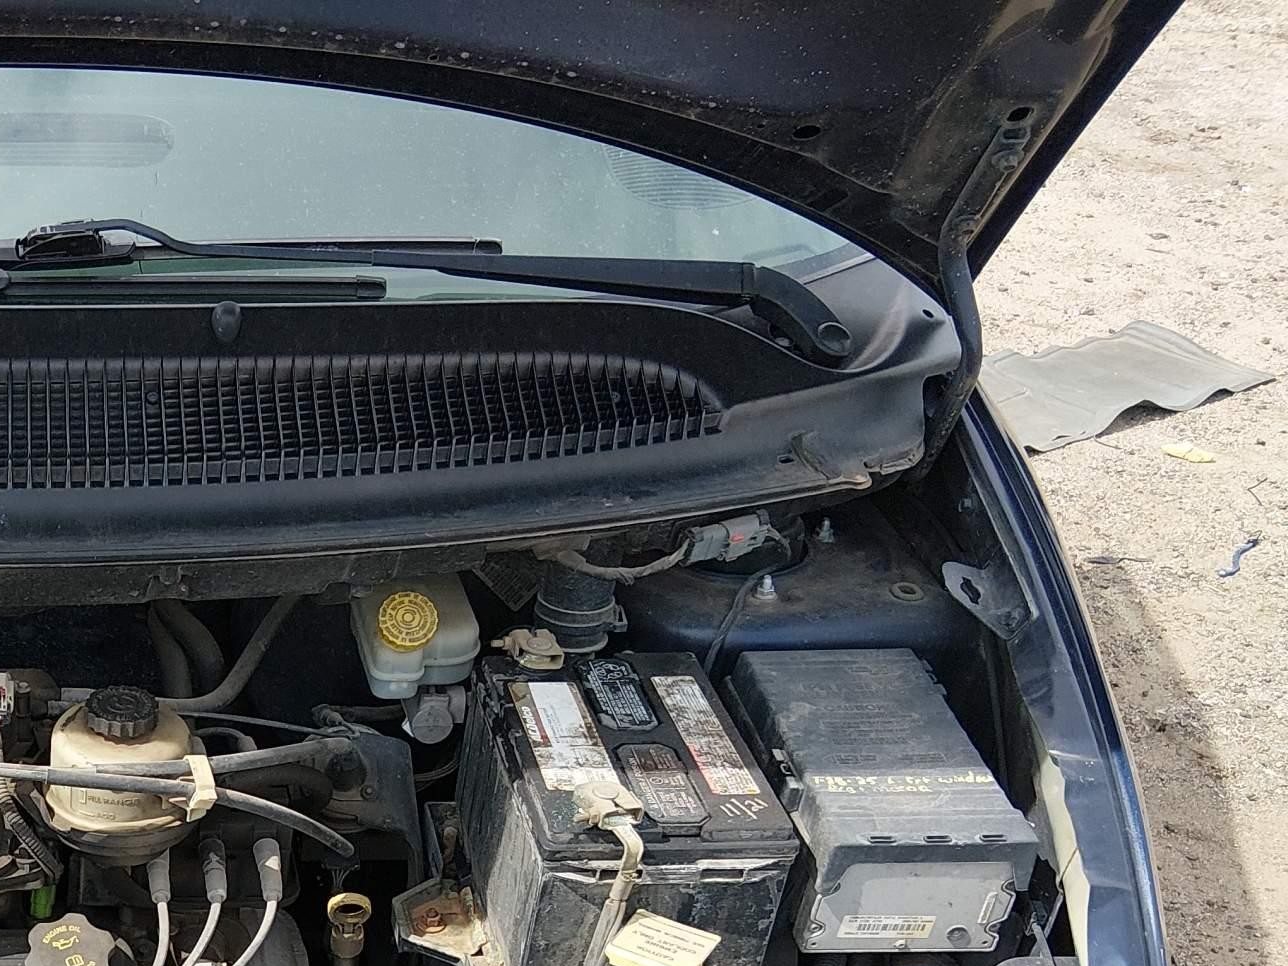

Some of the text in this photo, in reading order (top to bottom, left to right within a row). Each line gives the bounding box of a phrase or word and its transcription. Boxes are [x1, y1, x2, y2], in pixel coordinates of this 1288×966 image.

[719, 798, 769, 820] 11/21
[42, 925, 82, 944] ENGINE OIL
